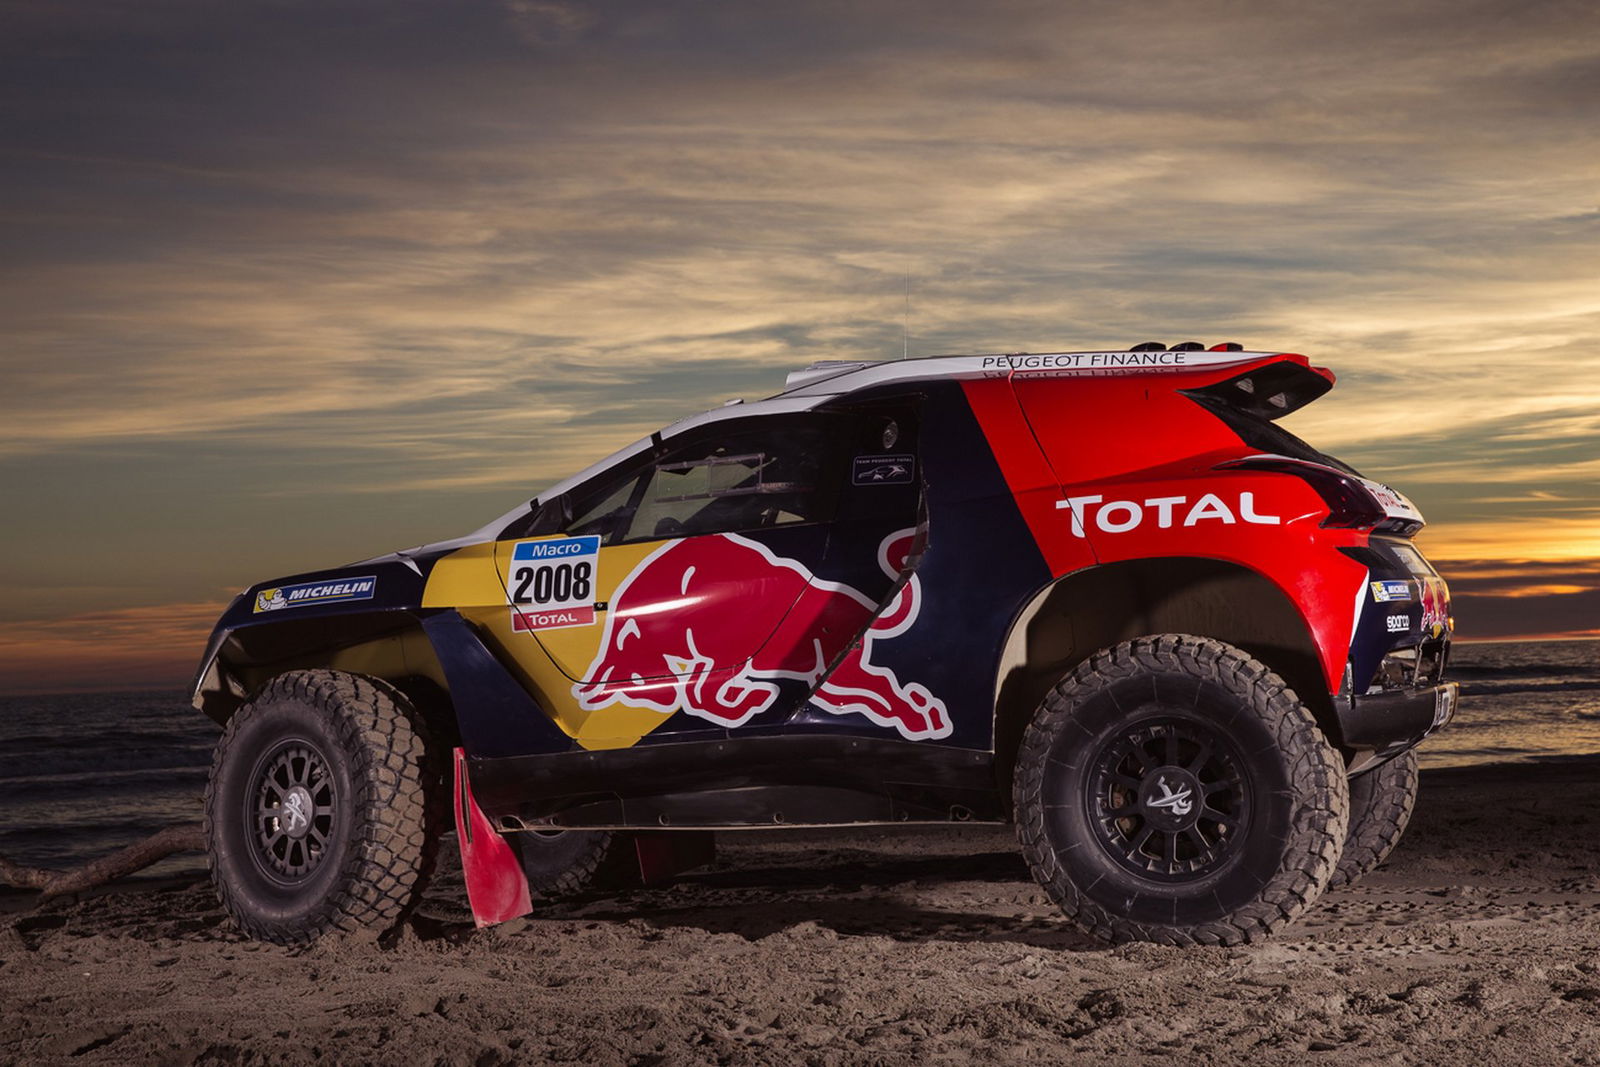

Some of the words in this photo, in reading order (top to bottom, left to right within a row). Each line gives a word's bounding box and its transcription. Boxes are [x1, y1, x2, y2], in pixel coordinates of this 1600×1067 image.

[982, 354, 1084, 369] PEUGEOT
[1091, 352, 1186, 366] FINANCE
[1055, 492, 1281, 538] TOTAL
[532, 542, 581, 558] Macro
[289, 580, 373, 600] MICHELIN
[514, 561, 592, 604] 2008
[530, 612, 578, 626] TOTAL
